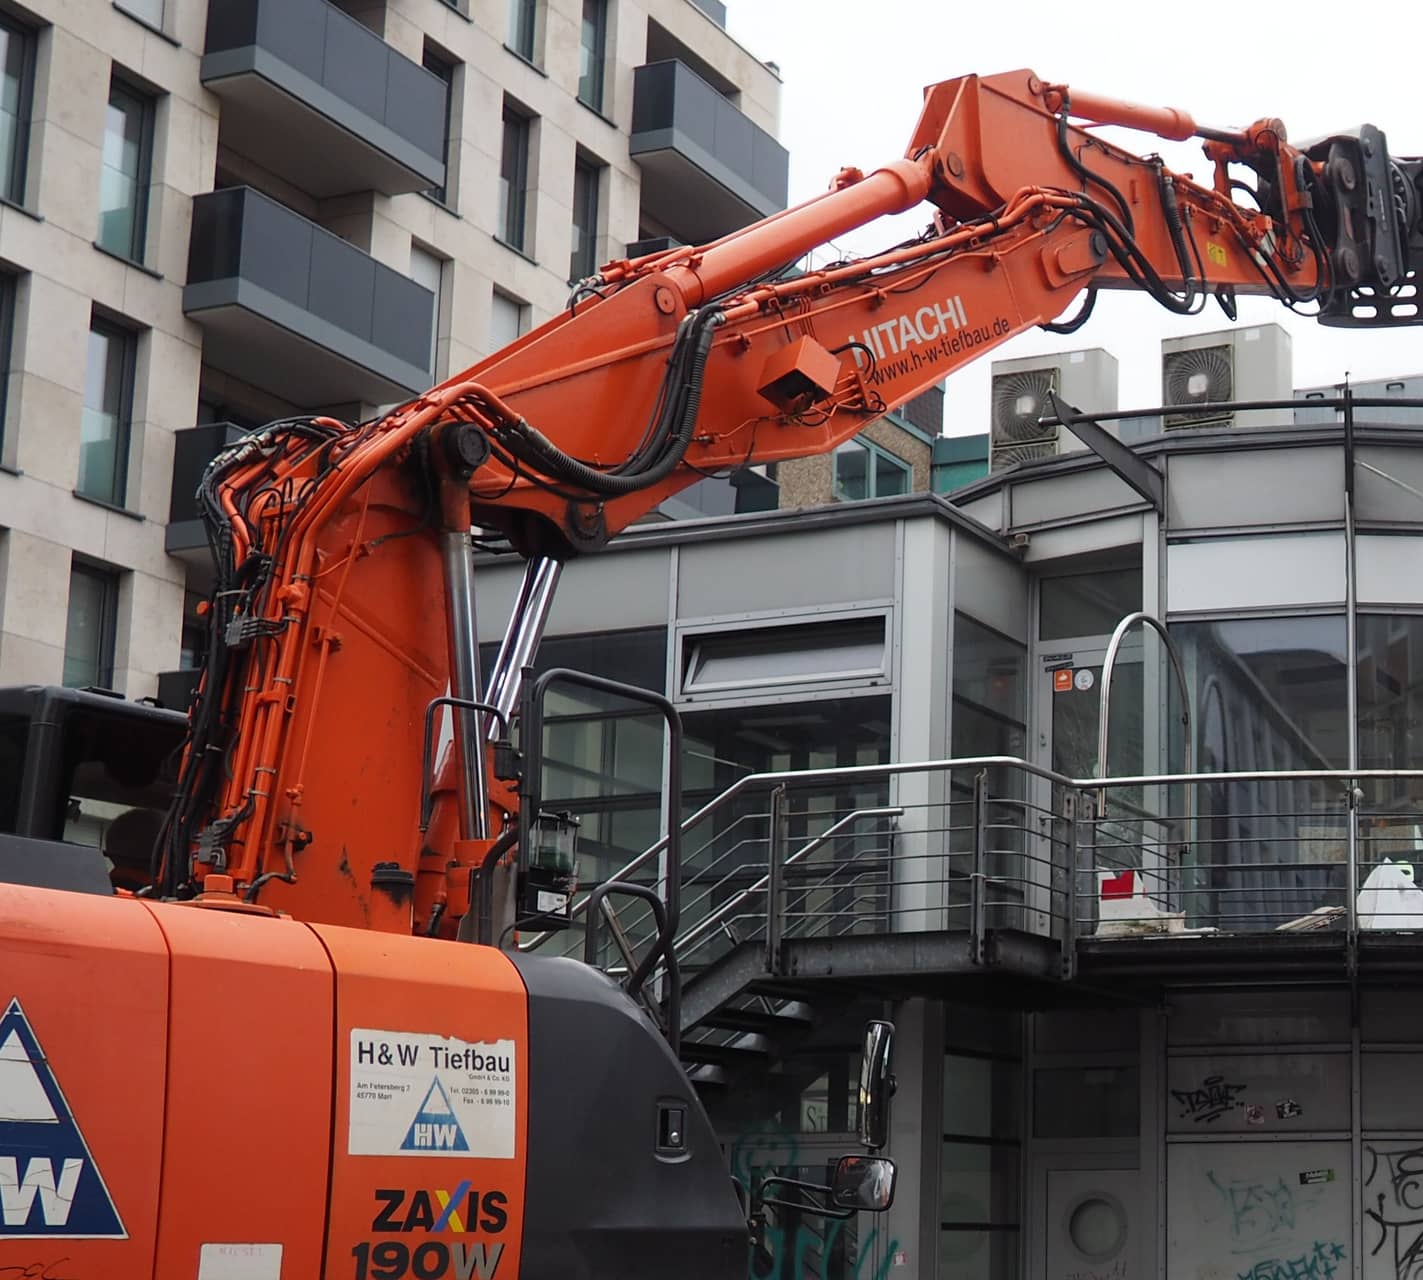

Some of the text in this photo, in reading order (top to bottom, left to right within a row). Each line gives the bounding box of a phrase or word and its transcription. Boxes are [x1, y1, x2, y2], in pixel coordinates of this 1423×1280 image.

[849, 295, 969, 367] HITACHI
[872, 316, 1011, 385] www.h-w-tiefbau.de
[358, 1041, 510, 1073] H&W Tiefbau
[414, 1123, 458, 1146] HW
[372, 1179, 509, 1234] ZAXIS
[352, 1241, 506, 1280] 190W
